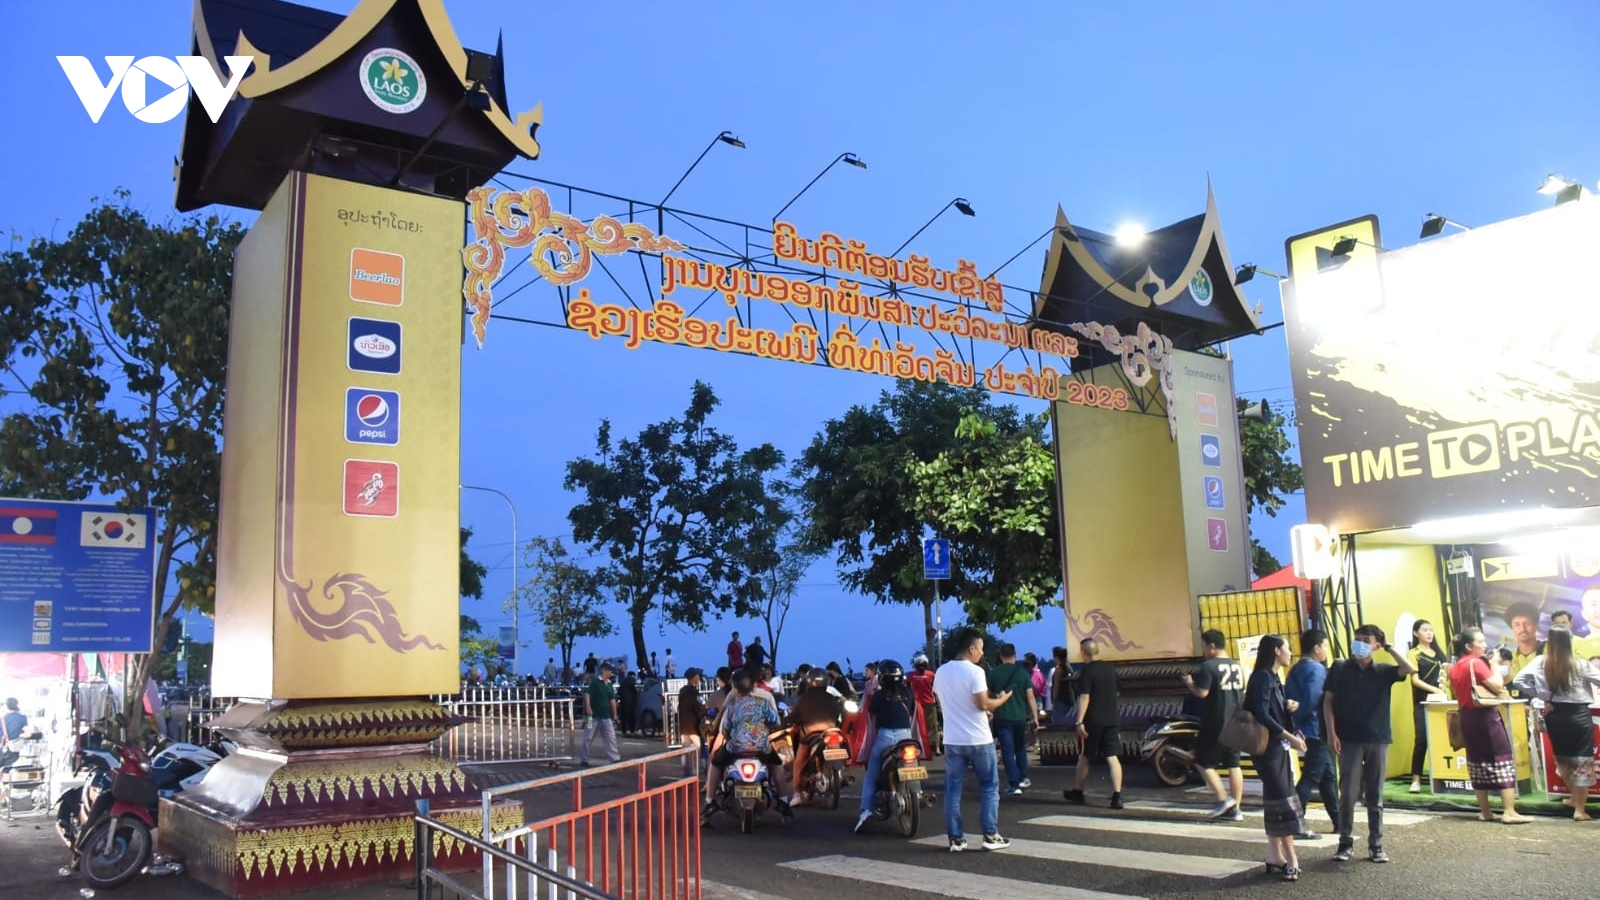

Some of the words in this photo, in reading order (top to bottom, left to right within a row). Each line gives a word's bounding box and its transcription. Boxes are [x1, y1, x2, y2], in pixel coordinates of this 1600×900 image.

[373, 77, 410, 98] LAOS
[355, 269, 401, 286] Beerlao
[1032, 327, 1079, 358] ແລະ
[1066, 381, 1129, 412] 2023
[359, 429, 386, 440] pepsi
[1323, 442, 1423, 487] TIME
[1430, 430, 1494, 472] TO
[1504, 411, 1600, 463] PLA
[1218, 663, 1244, 690] 23
[1444, 781, 1464, 789] TIME
